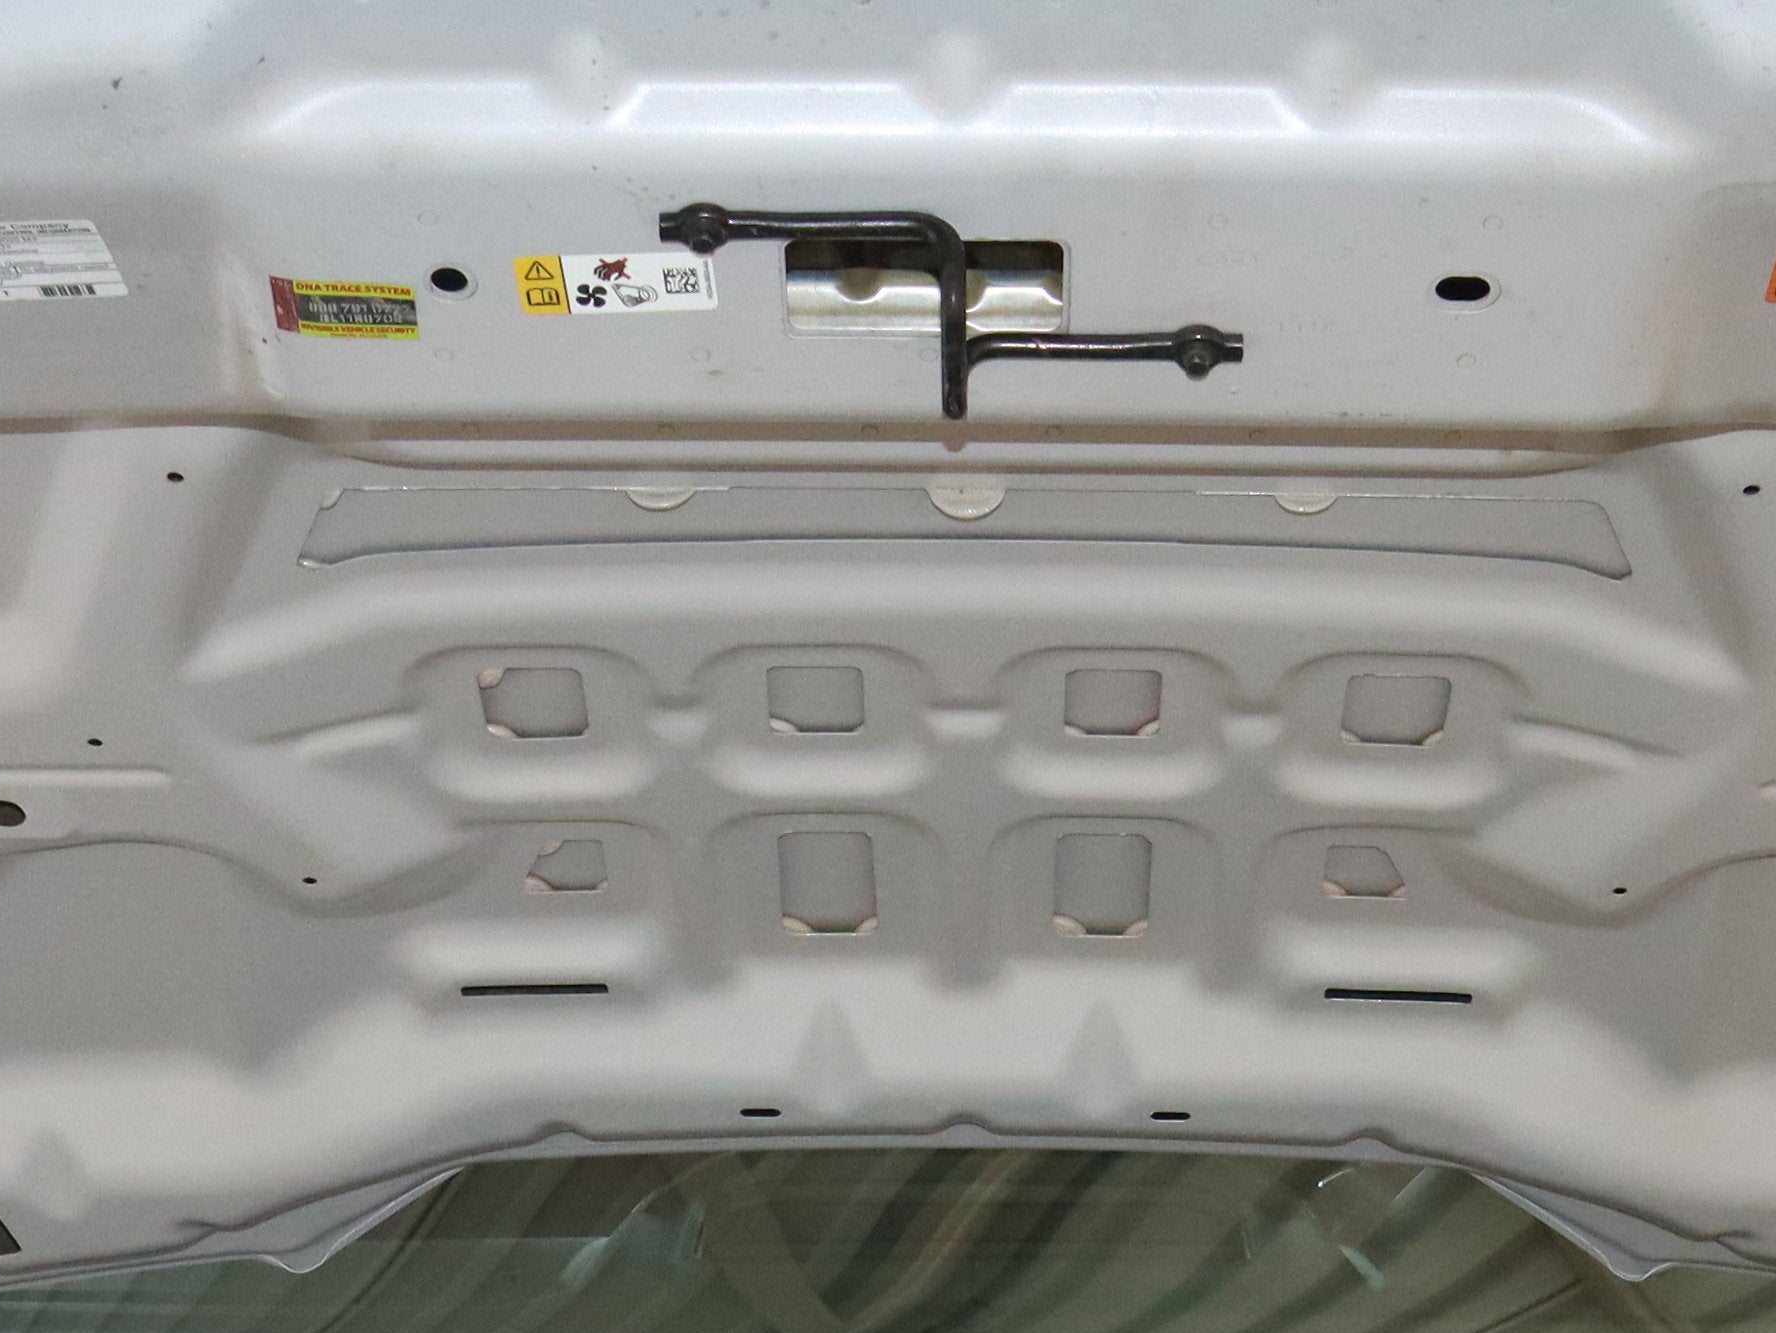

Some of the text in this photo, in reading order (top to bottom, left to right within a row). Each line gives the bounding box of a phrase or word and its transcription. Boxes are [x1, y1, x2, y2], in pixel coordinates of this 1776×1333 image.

[10, 223, 69, 231] Company
[296, 282, 411, 296] DNA TRACE SYSTEM
[376, 326, 415, 334] SECURITY
